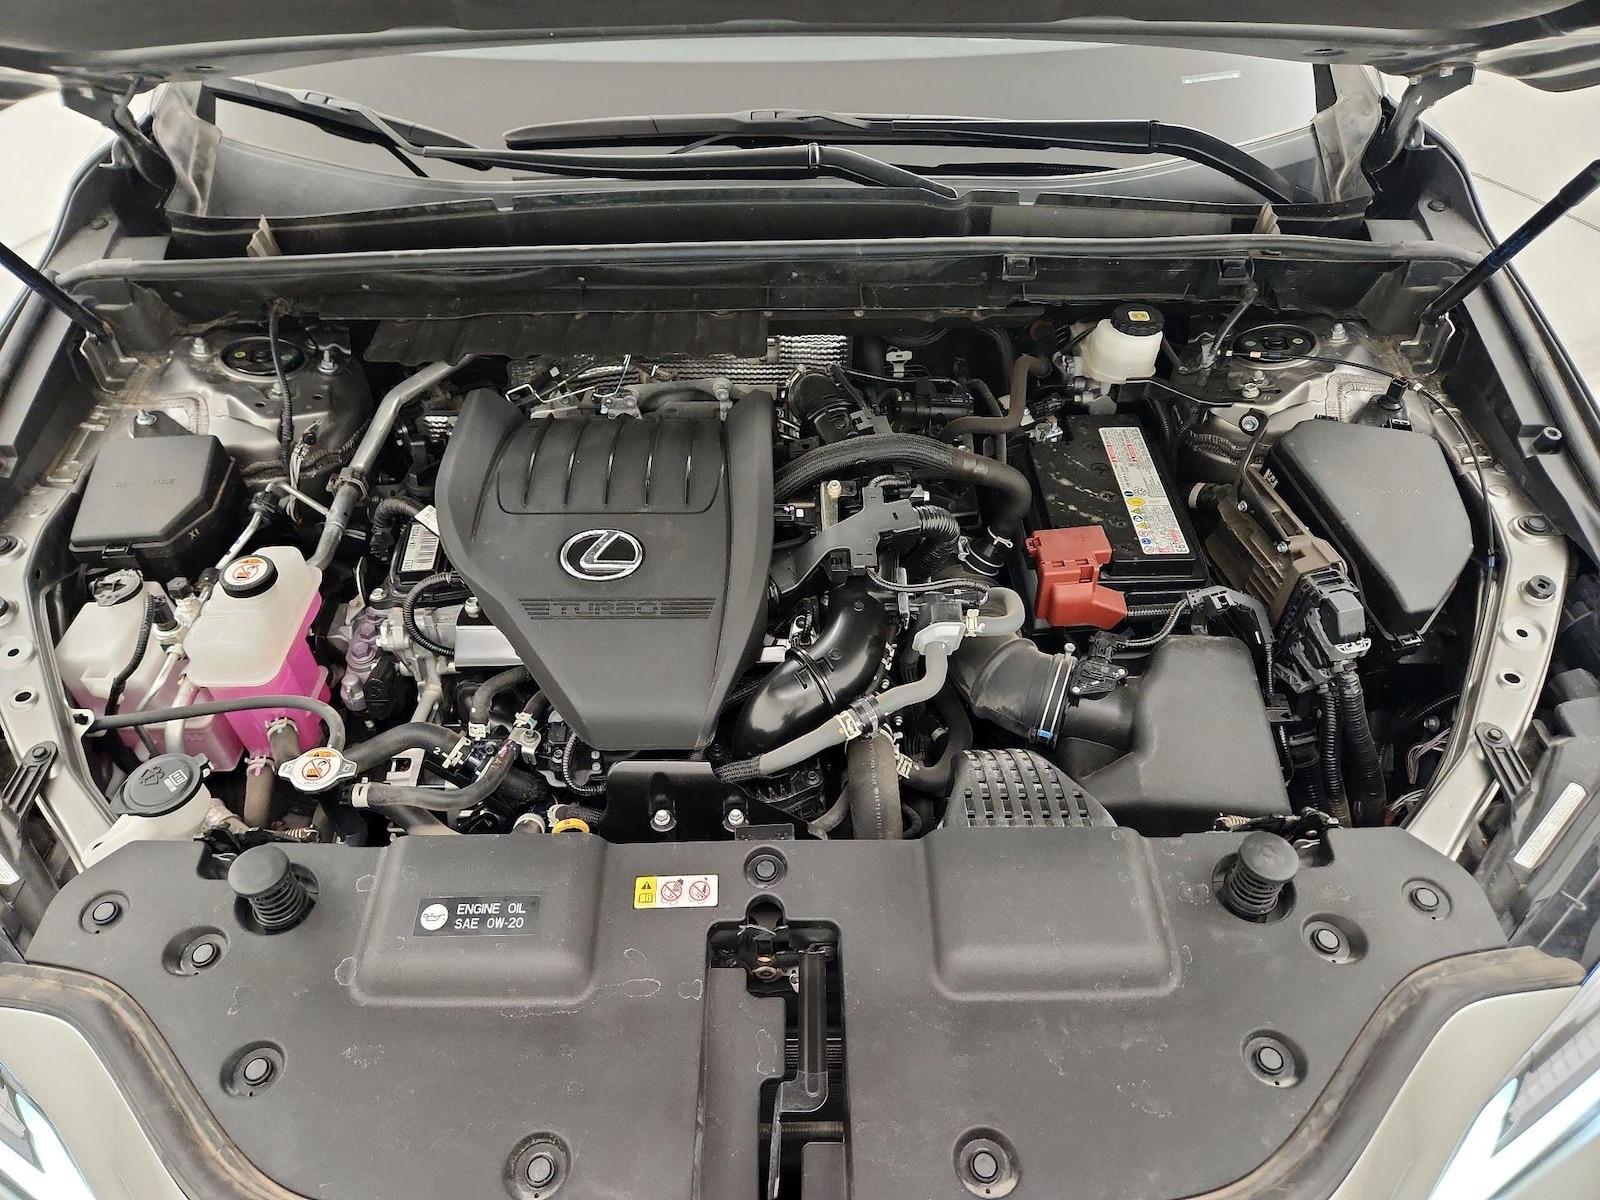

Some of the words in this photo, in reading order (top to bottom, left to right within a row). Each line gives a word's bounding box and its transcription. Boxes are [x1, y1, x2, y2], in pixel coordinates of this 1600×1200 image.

[552, 602, 658, 615] TURBO
[456, 903, 501, 914] ENGINE
[507, 902, 526, 914] OIL
[454, 918, 480, 929] SAE
[486, 917, 524, 929] 0W-20
